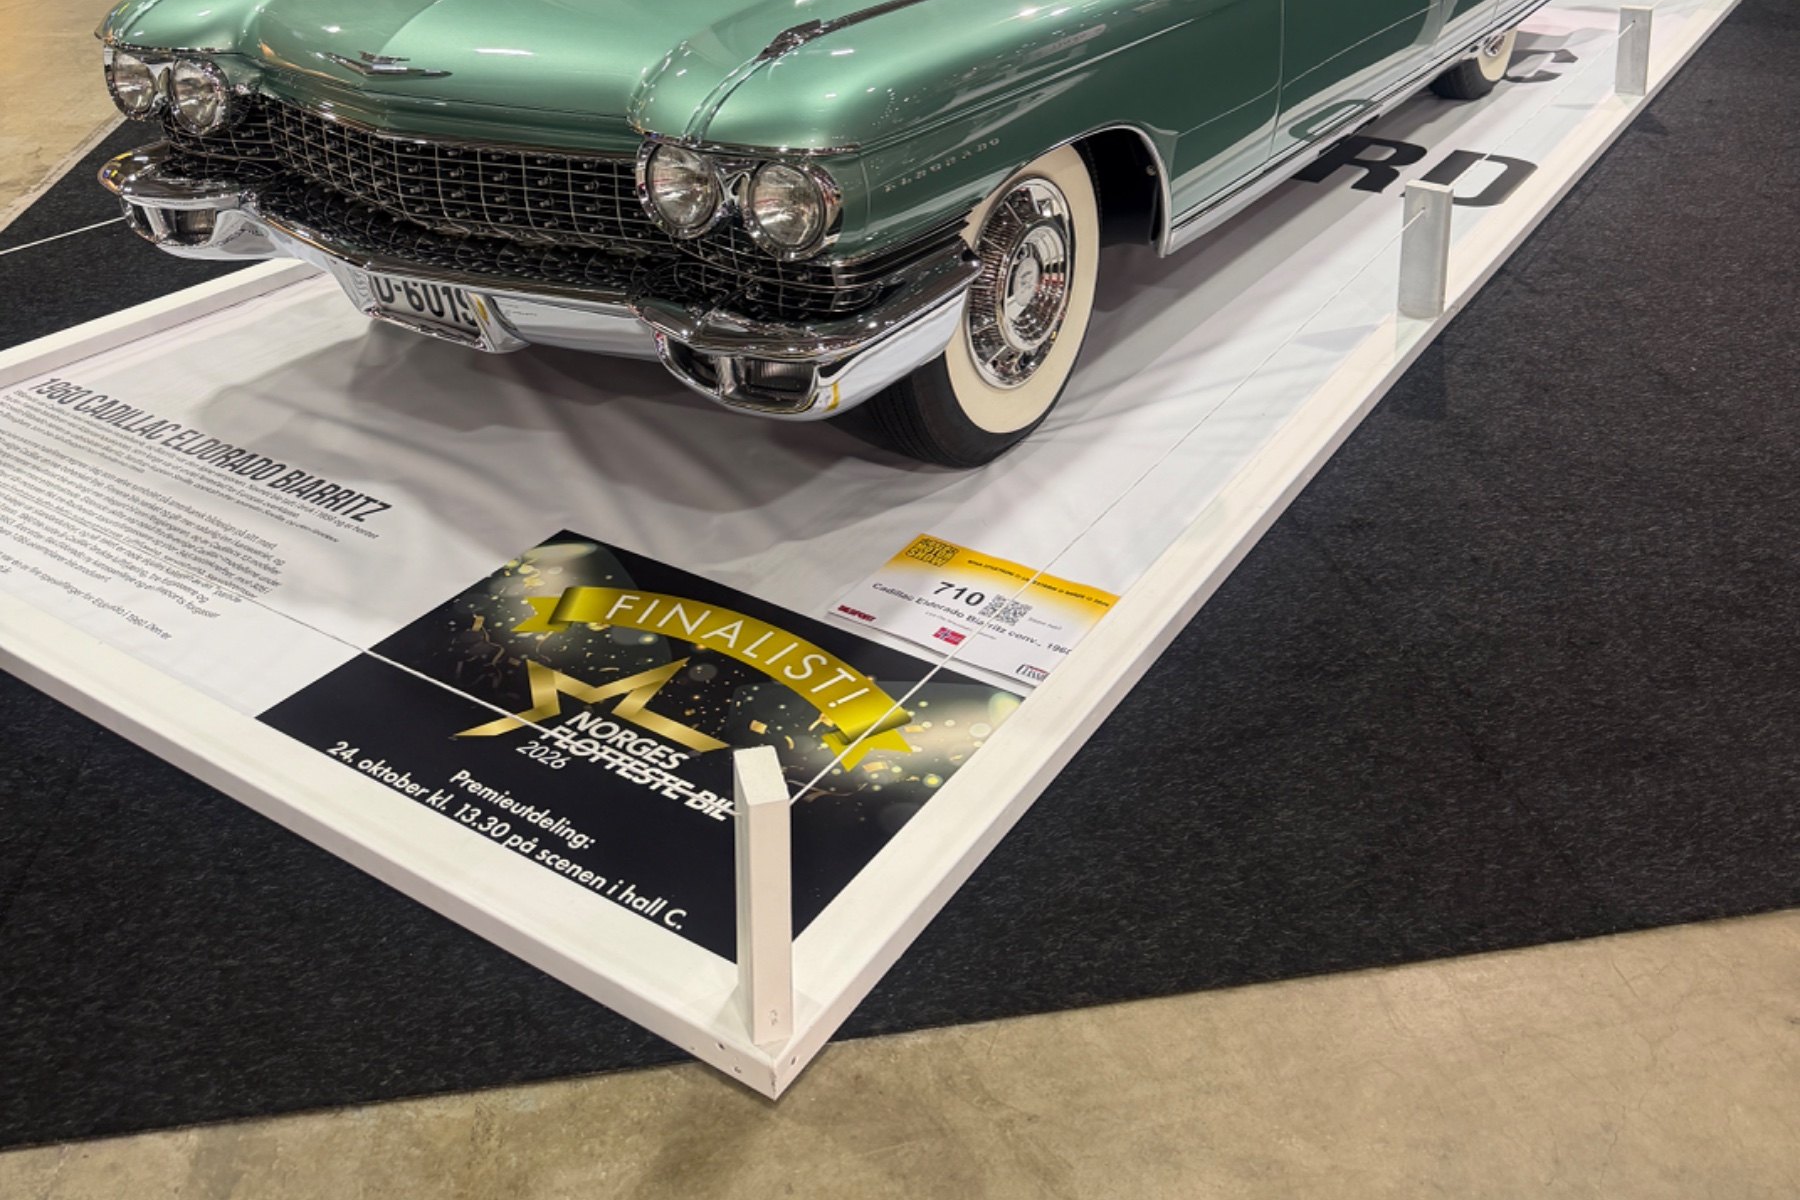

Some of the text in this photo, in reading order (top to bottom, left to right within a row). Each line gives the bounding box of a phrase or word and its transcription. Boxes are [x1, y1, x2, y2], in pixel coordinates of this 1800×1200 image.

[28, 378, 94, 404] 1960
[73, 394, 182, 440] CADILLAC
[160, 429, 287, 481] ELDORADO
[267, 469, 392, 522] BIARRITZ
[934, 581, 986, 607] 710
[605, 594, 870, 708] FINALIST!
[516, 740, 572, 769] 2026
[565, 710, 690, 770] NORGES
[326, 740, 689, 931] 24. oktober kl. 13.30 på scenen i hall C.
[449, 769, 596, 850] Premieutdeling:
[685, 790, 738, 823] BIL
